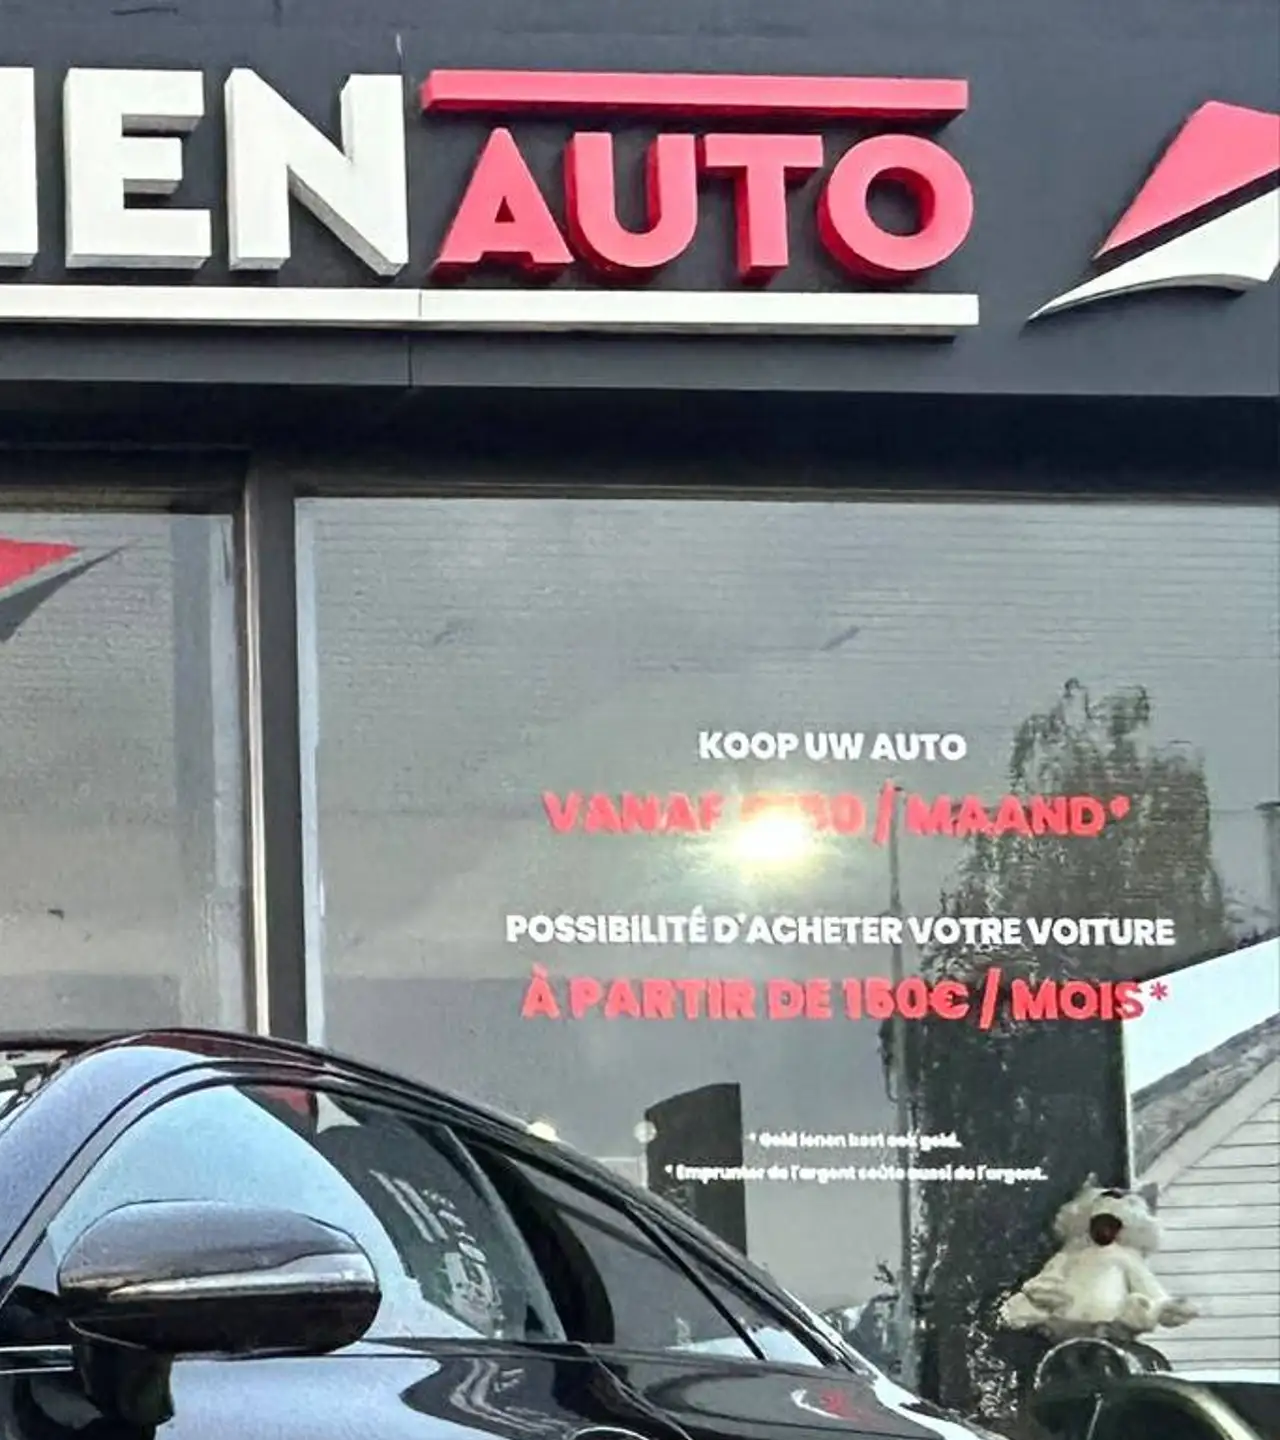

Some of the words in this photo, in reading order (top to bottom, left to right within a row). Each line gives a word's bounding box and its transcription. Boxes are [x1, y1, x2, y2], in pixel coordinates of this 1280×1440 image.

[698, 731, 799, 760] KOOP
[805, 731, 864, 760] UW
[870, 732, 967, 761] AUTO
[542, 791, 724, 834] VANAF
[506, 906, 709, 944] POSSIBILITÉ
[713, 912, 902, 946] D'ACHETER
[907, 916, 1023, 946] VOTRE
[1028, 918, 1176, 946] VOITURE
[521, 962, 560, 1020] À
[568, 976, 757, 1020] PARTIR
[765, 977, 833, 1020] DE
